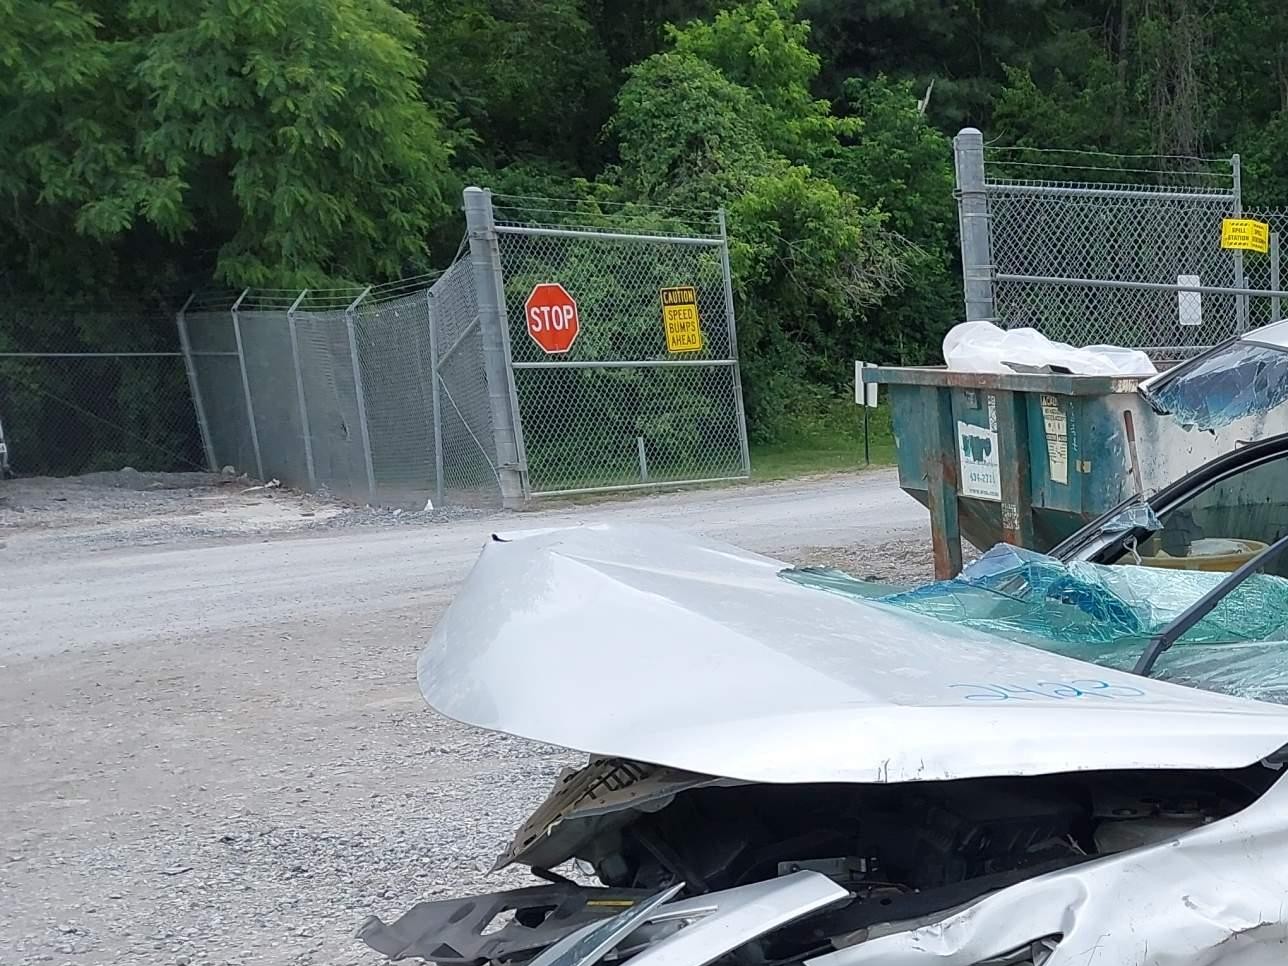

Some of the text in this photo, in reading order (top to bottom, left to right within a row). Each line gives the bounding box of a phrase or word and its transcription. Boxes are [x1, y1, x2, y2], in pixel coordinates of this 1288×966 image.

[663, 290, 694, 304] CAUTION
[530, 305, 574, 332] STOP
[668, 308, 693, 321] SPEED
[669, 321, 696, 334] BUMPS
[671, 334, 697, 347] AHEAD
